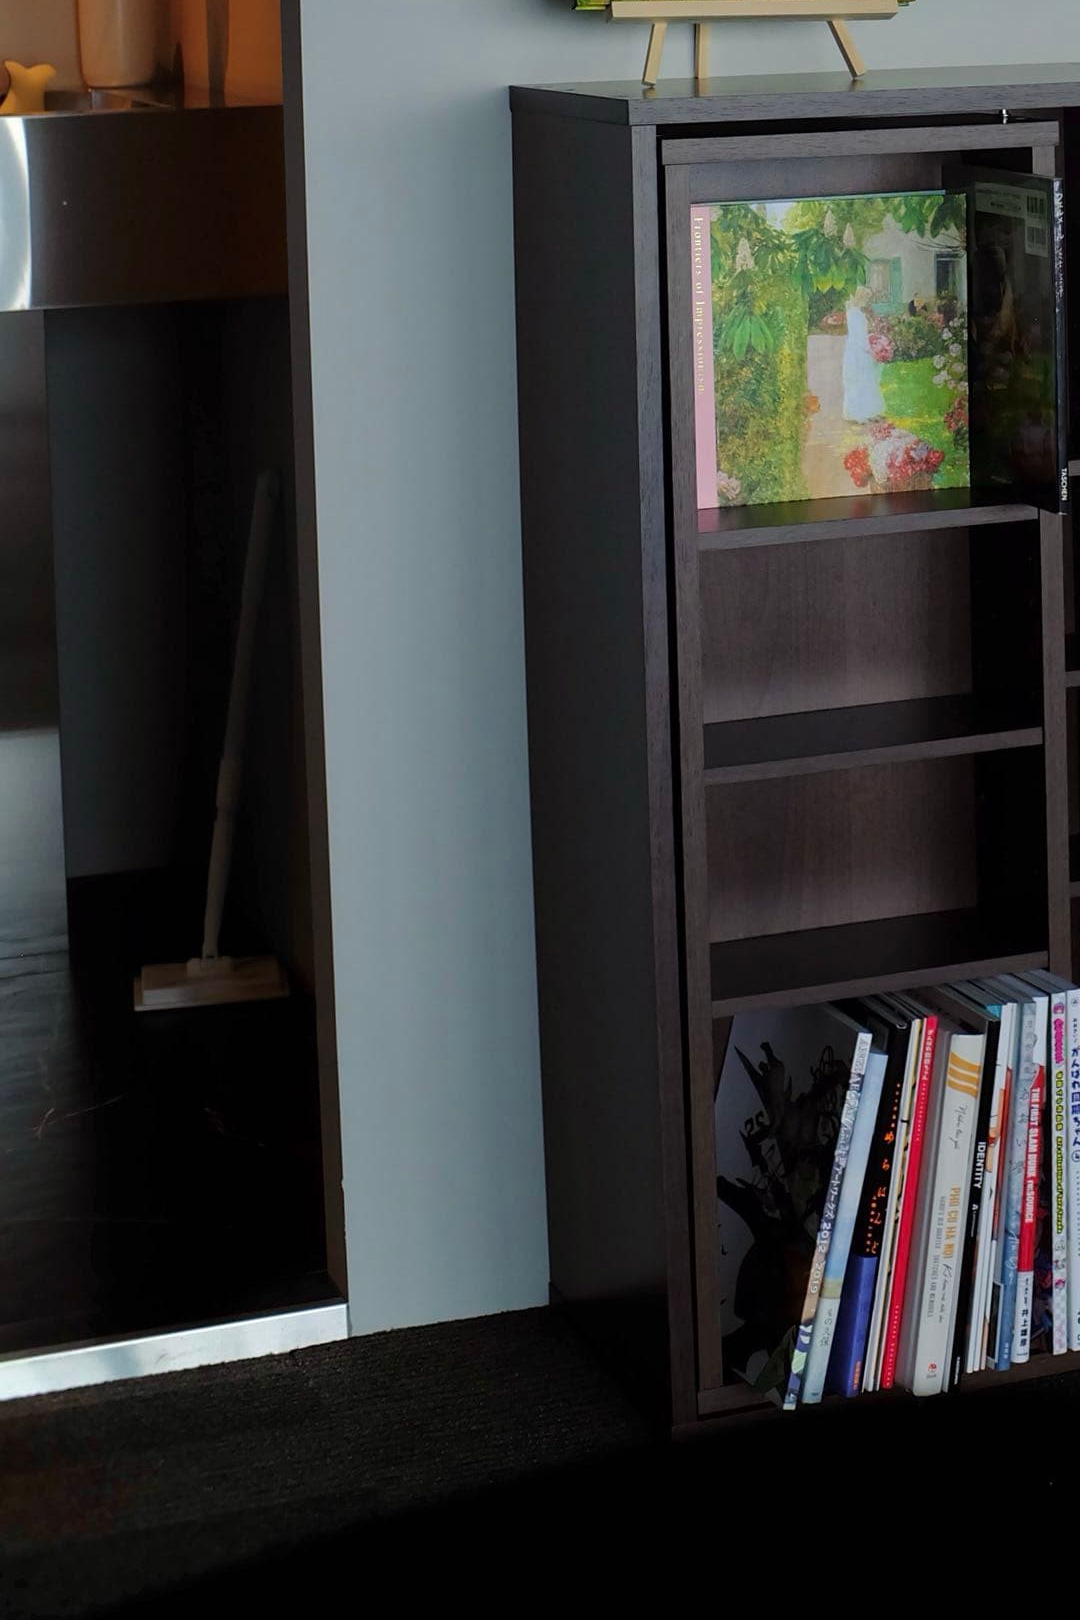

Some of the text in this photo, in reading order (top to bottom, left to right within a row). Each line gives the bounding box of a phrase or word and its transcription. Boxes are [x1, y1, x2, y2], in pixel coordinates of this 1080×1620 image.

[693, 216, 704, 276] Frontiers
[695, 283, 705, 294] of
[1060, 467, 1068, 501] TASCHEN
[1030, 1087, 1040, 1103] THE
[1029, 1104, 1039, 1126] FIRST
[1028, 1128, 1038, 1153] SLAM
[974, 1141, 987, 1189] IDENTITY
[1027, 1154, 1037, 1178] DUNK
[818, 1222, 832, 1252] 2012
[810, 1262, 823, 1293] 2019
